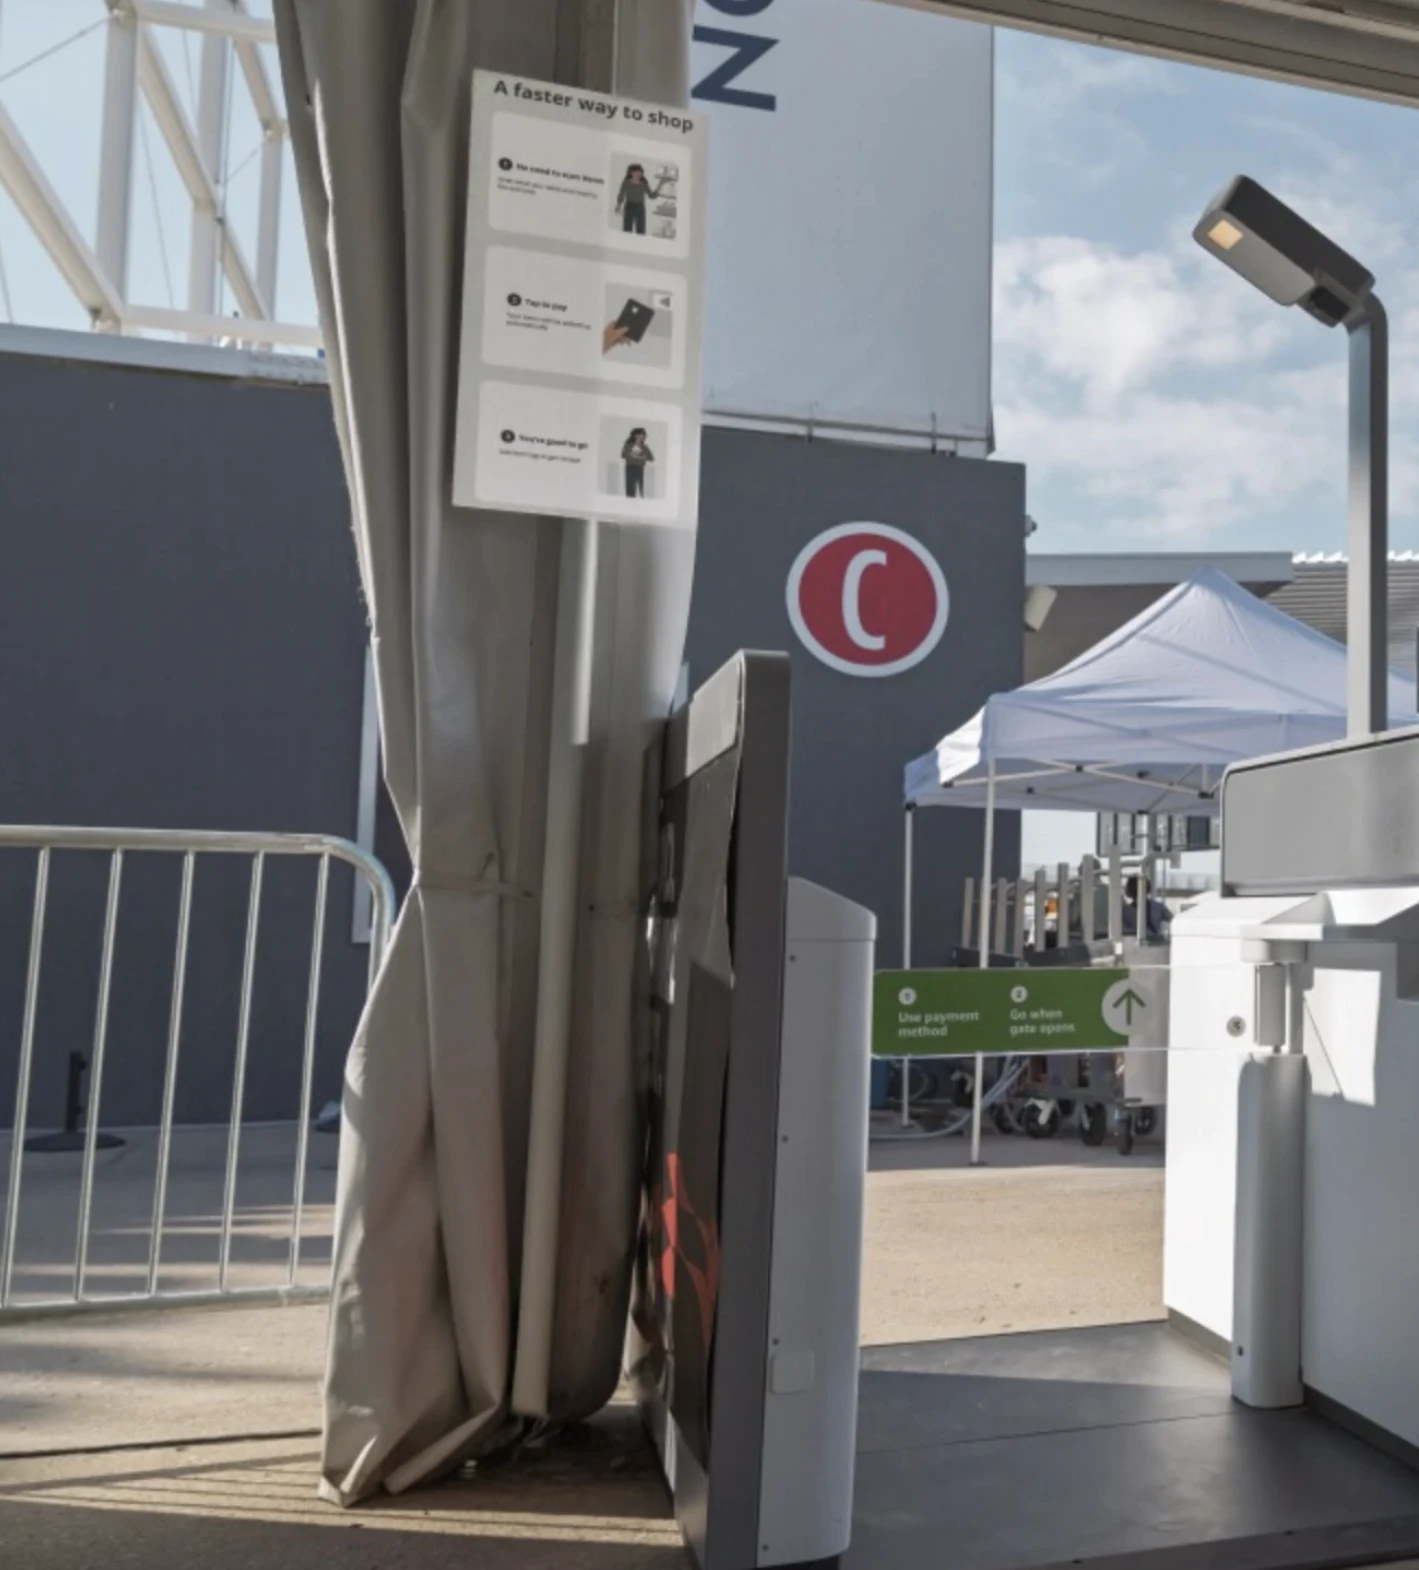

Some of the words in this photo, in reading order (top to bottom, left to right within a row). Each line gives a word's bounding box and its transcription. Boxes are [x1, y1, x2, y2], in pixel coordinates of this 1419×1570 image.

[691, 0, 780, 112] N
[494, 80, 508, 95] A
[513, 82, 573, 107] faster
[578, 96, 617, 118] way
[623, 106, 642, 121] to
[648, 110, 694, 134] shop
[898, 1011, 921, 1023] Use
[924, 1010, 980, 1025] payment
[1009, 1008, 1027, 1020] Go
[1030, 1008, 1063, 1020] when
[898, 1024, 948, 1038] method
[1009, 1024, 1037, 1037] gate
[1040, 1022, 1075, 1036] opens
